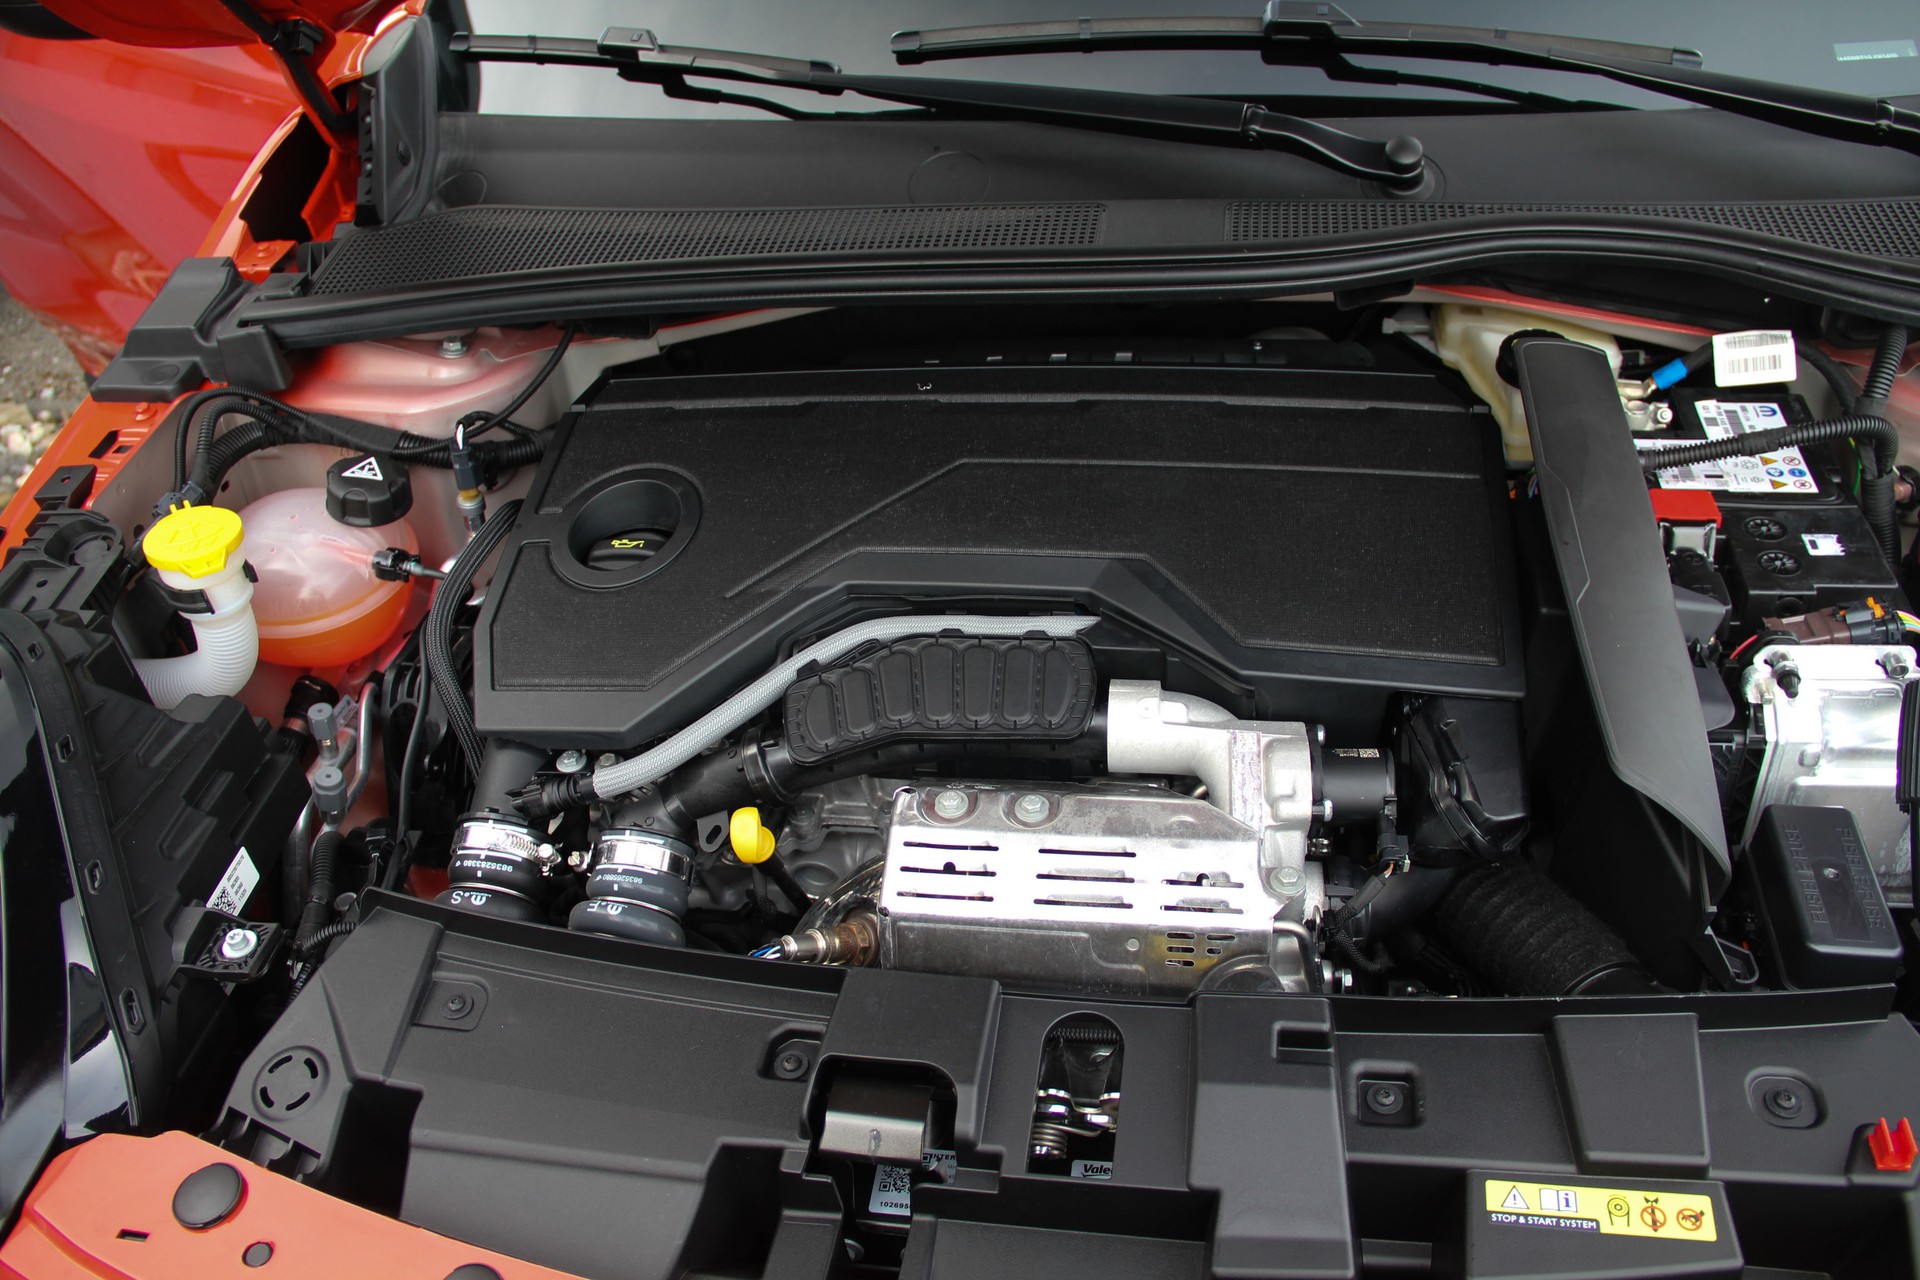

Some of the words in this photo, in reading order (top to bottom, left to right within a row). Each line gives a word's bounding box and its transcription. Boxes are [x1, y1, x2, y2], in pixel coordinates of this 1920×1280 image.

[1783, 824, 1829, 924] FUSIBLE/FUSE
[1836, 828, 1886, 928] FUSIBLE/FUSE
[1083, 1163, 1112, 1174] Vale
[879, 1201, 911, 1209] 102695
[1491, 1213, 1517, 1222] STOP
[1528, 1216, 1557, 1225] START
[1559, 1218, 1597, 1229] SYSTEM
